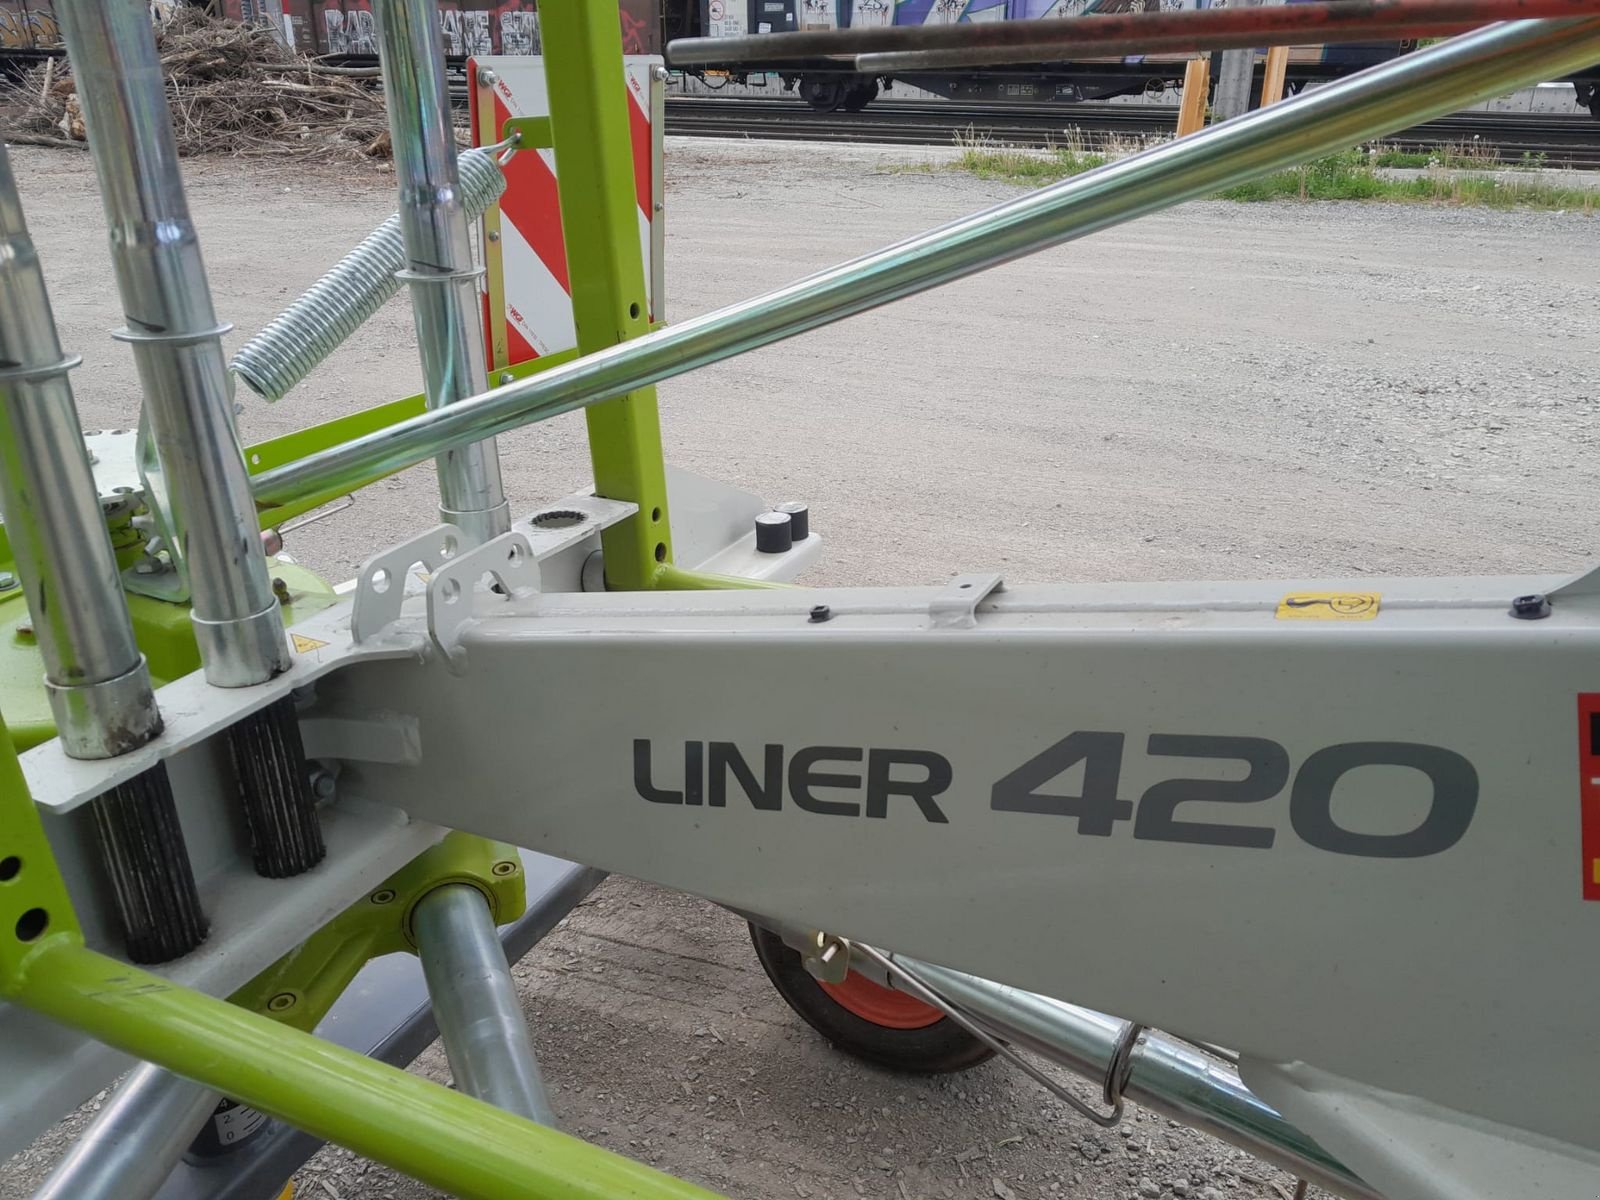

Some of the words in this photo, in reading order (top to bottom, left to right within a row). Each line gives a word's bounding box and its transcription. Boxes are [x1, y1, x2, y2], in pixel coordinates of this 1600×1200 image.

[633, 738, 953, 824] LINER
[990, 730, 1480, 858] 420
[224, 1114, 231, 1124] 2
[226, 1131, 234, 1140] 0
